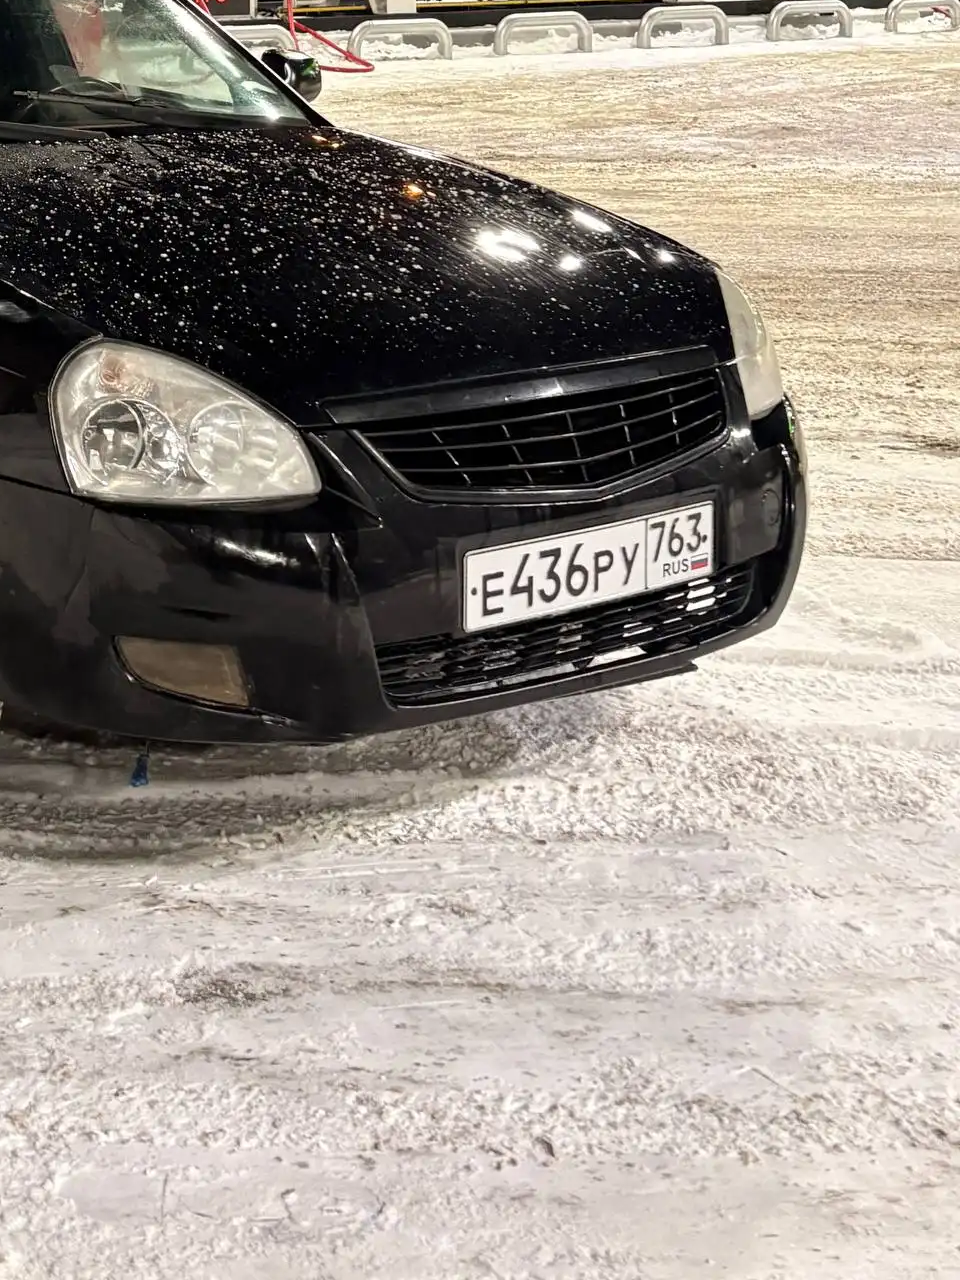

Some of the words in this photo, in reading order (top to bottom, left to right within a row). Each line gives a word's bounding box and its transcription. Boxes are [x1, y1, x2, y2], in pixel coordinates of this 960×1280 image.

[481, 543, 640, 617] Е436РУ
[649, 512, 703, 563] 763
[663, 558, 689, 578] RUS
